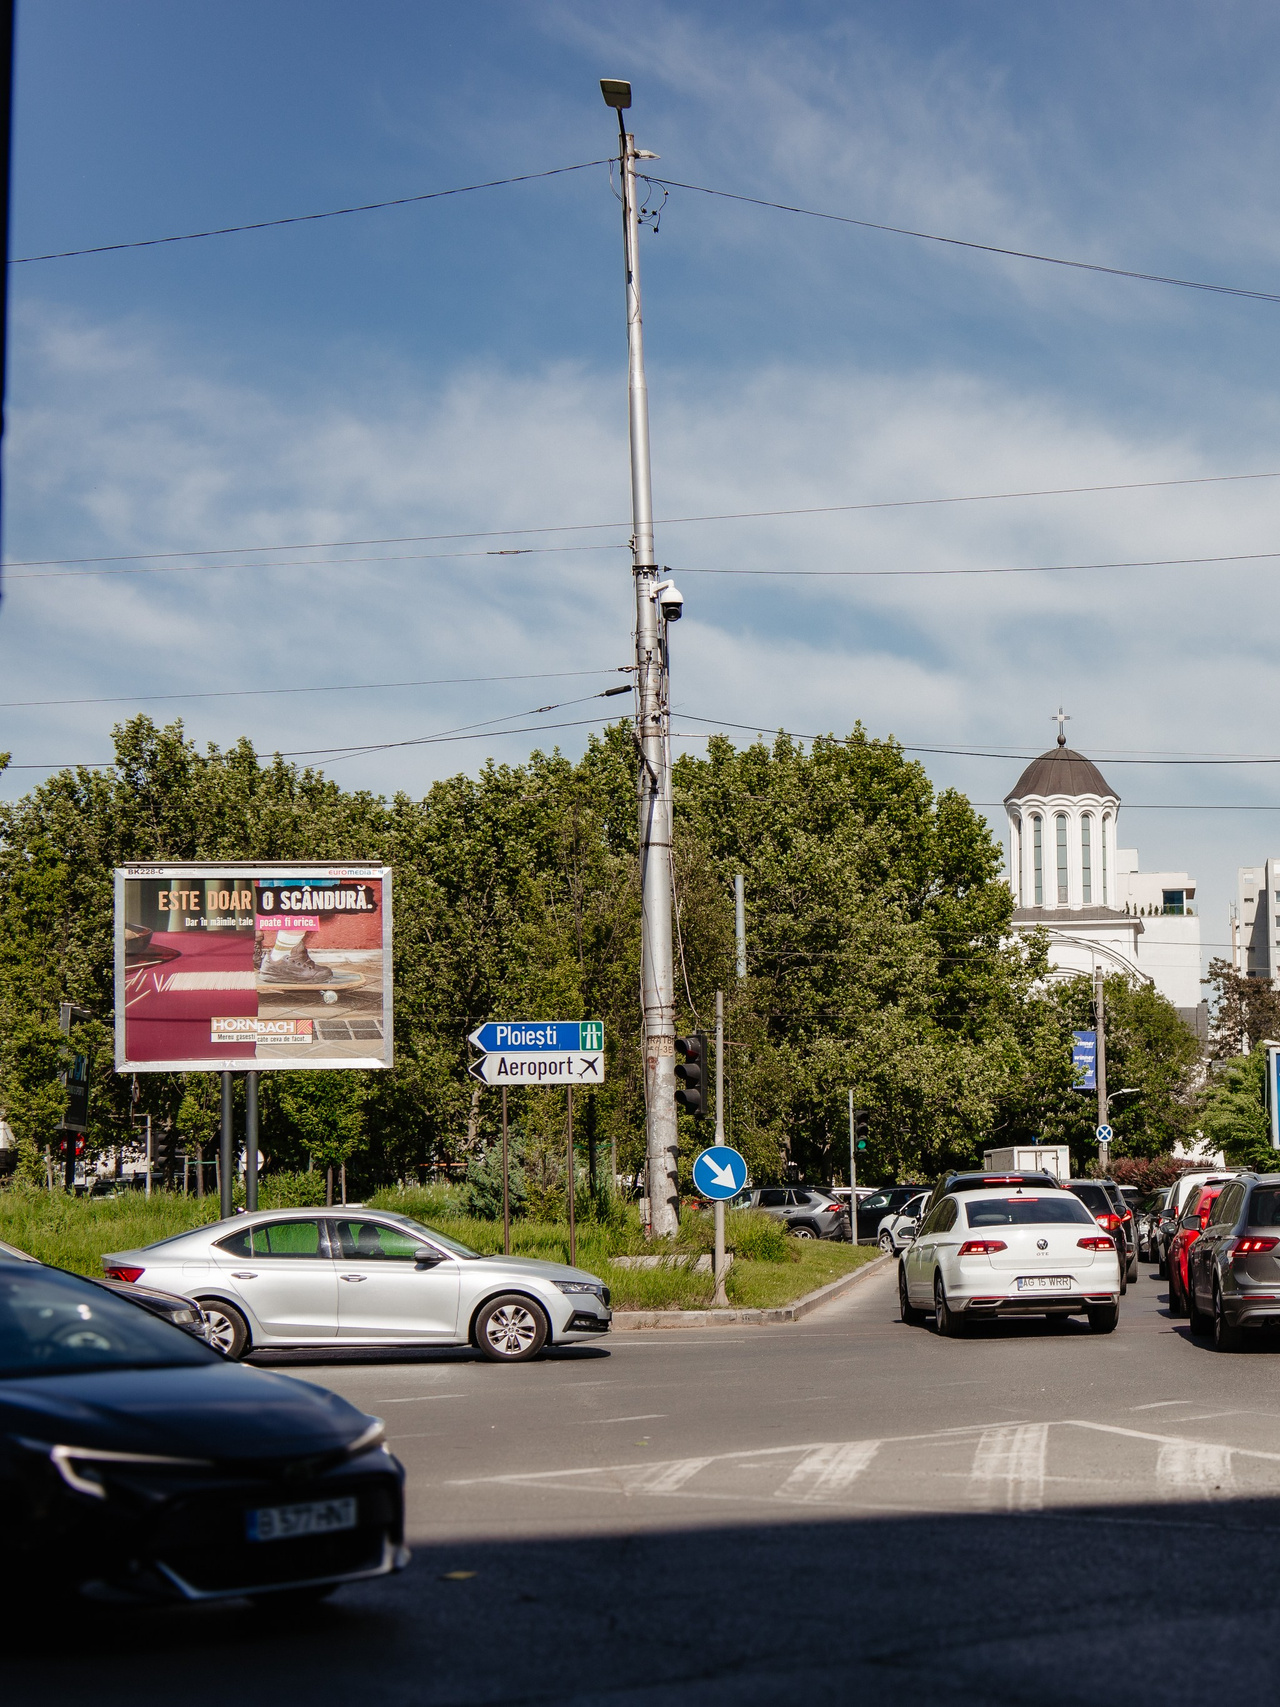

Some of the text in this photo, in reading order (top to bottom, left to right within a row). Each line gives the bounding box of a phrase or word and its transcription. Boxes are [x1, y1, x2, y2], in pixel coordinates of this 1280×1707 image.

[158, 885, 373, 911] ESTE DOAR O SCÂNDURĂ.
[185, 916, 316, 928] Dar în mâinile tale poate fi orice.
[213, 1019, 294, 1033] HORNBACH
[496, 1026, 557, 1049] Ploiești
[497, 1056, 573, 1081] Aeroport
[1023, 1277, 1069, 1287] AG 15 WRR
